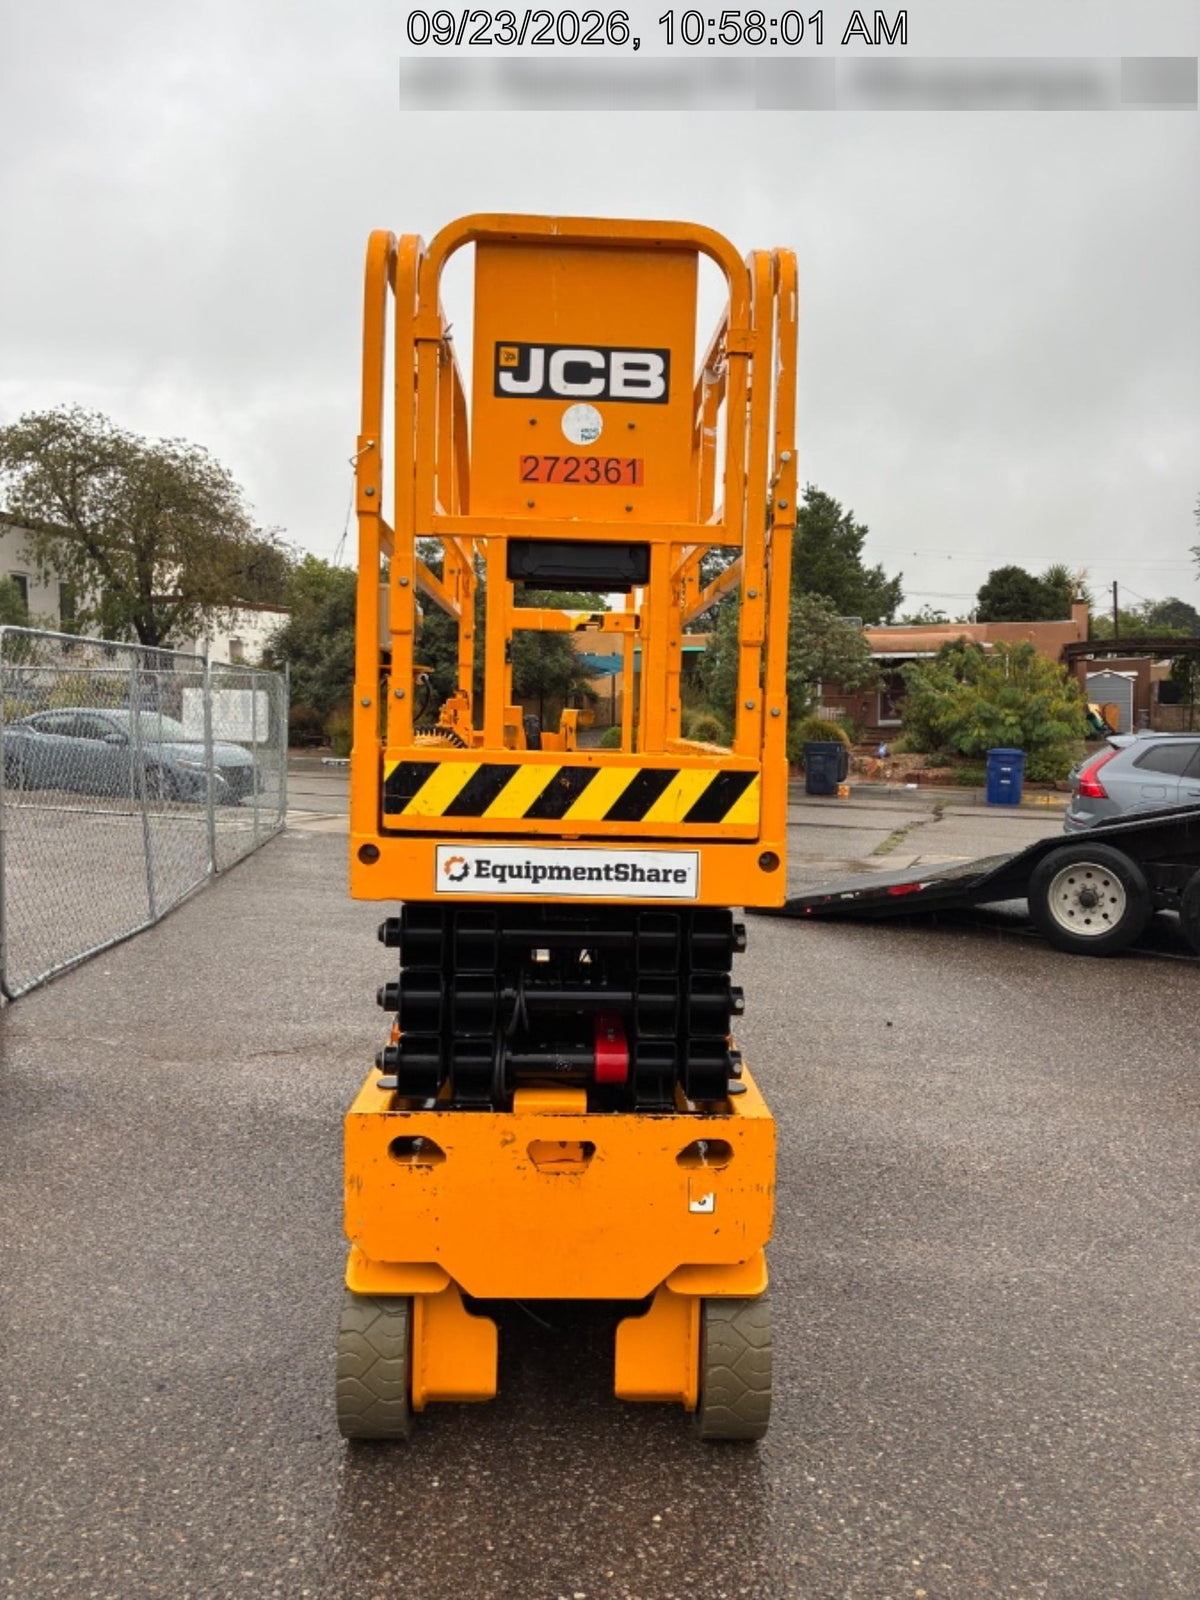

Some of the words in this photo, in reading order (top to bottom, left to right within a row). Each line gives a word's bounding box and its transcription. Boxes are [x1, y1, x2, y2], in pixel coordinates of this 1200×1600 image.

[499, 347, 666, 399] JCB
[522, 455, 638, 485] 272361
[474, 859, 688, 884] EquipmentShare
